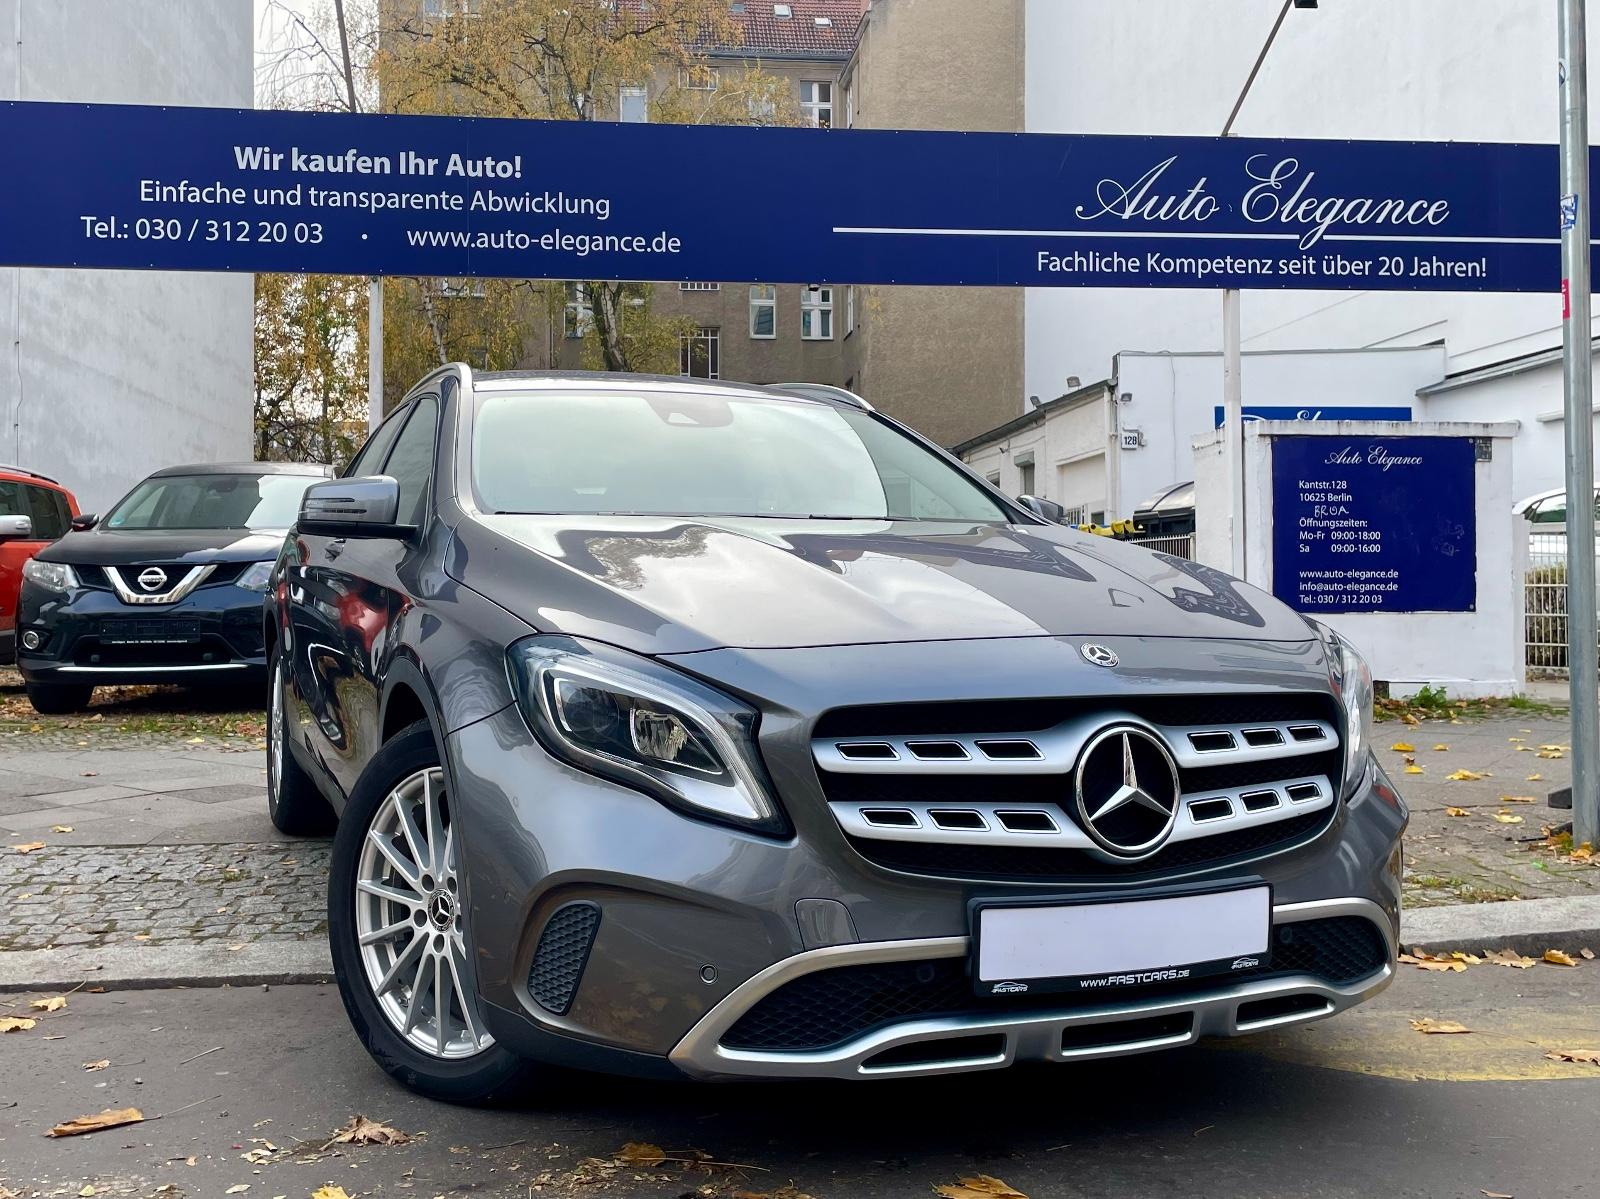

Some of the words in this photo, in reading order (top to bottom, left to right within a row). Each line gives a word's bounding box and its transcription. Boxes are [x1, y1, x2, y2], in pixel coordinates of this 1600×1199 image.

[234, 146, 283, 170] Wir
[292, 147, 390, 173] kaufen
[400, 151, 438, 175] Ihr
[446, 154, 521, 178] Auto!
[141, 180, 245, 204] Einfache
[254, 184, 300, 205] und
[309, 187, 463, 213] transparente
[470, 190, 609, 220] Abwicklung
[1076, 156, 1219, 220] Auto
[1241, 153, 1450, 250] Elegance
[81, 216, 128, 238] Tel.:
[136, 219, 181, 239] 030
[206, 221, 249, 241] 312
[258, 222, 287, 242] 20
[295, 223, 322, 243] 03
[407, 229, 680, 256] www.auto-elegance.de
[1038, 251, 1140, 272] Fachliche
[1148, 253, 1272, 278] Kompetenz
[1279, 255, 1316, 274] seit
[1323, 255, 1372, 275] über
[1379, 257, 1403, 275] 20
[1410, 256, 1486, 277] Jahren!
[1124, 436, 1137, 445] 128
[1325, 447, 1363, 464] Auto
[1367, 446, 1423, 472] Elegance
[1299, 493, 1326, 502] 10625
[1327, 492, 1353, 502] Berlin
[1299, 517, 1368, 529] Öffnungszeiten:
[1299, 531, 1326, 540] Mo-Fr
[1331, 530, 1381, 541] 09:00-18:00
[1299, 543, 1310, 553] Sa
[1331, 543, 1381, 553] 09:00-16:00
[1299, 568, 1399, 580] www.auto-elegance.de
[1299, 581, 1399, 593] info@auto-elegance.de
[1299, 594, 1316, 604] Tel.:
[1317, 594, 1334, 604] 030
[1341, 594, 1358, 604] 312
[1359, 594, 1371, 604] 20
[1371, 594, 1383, 604] 03
